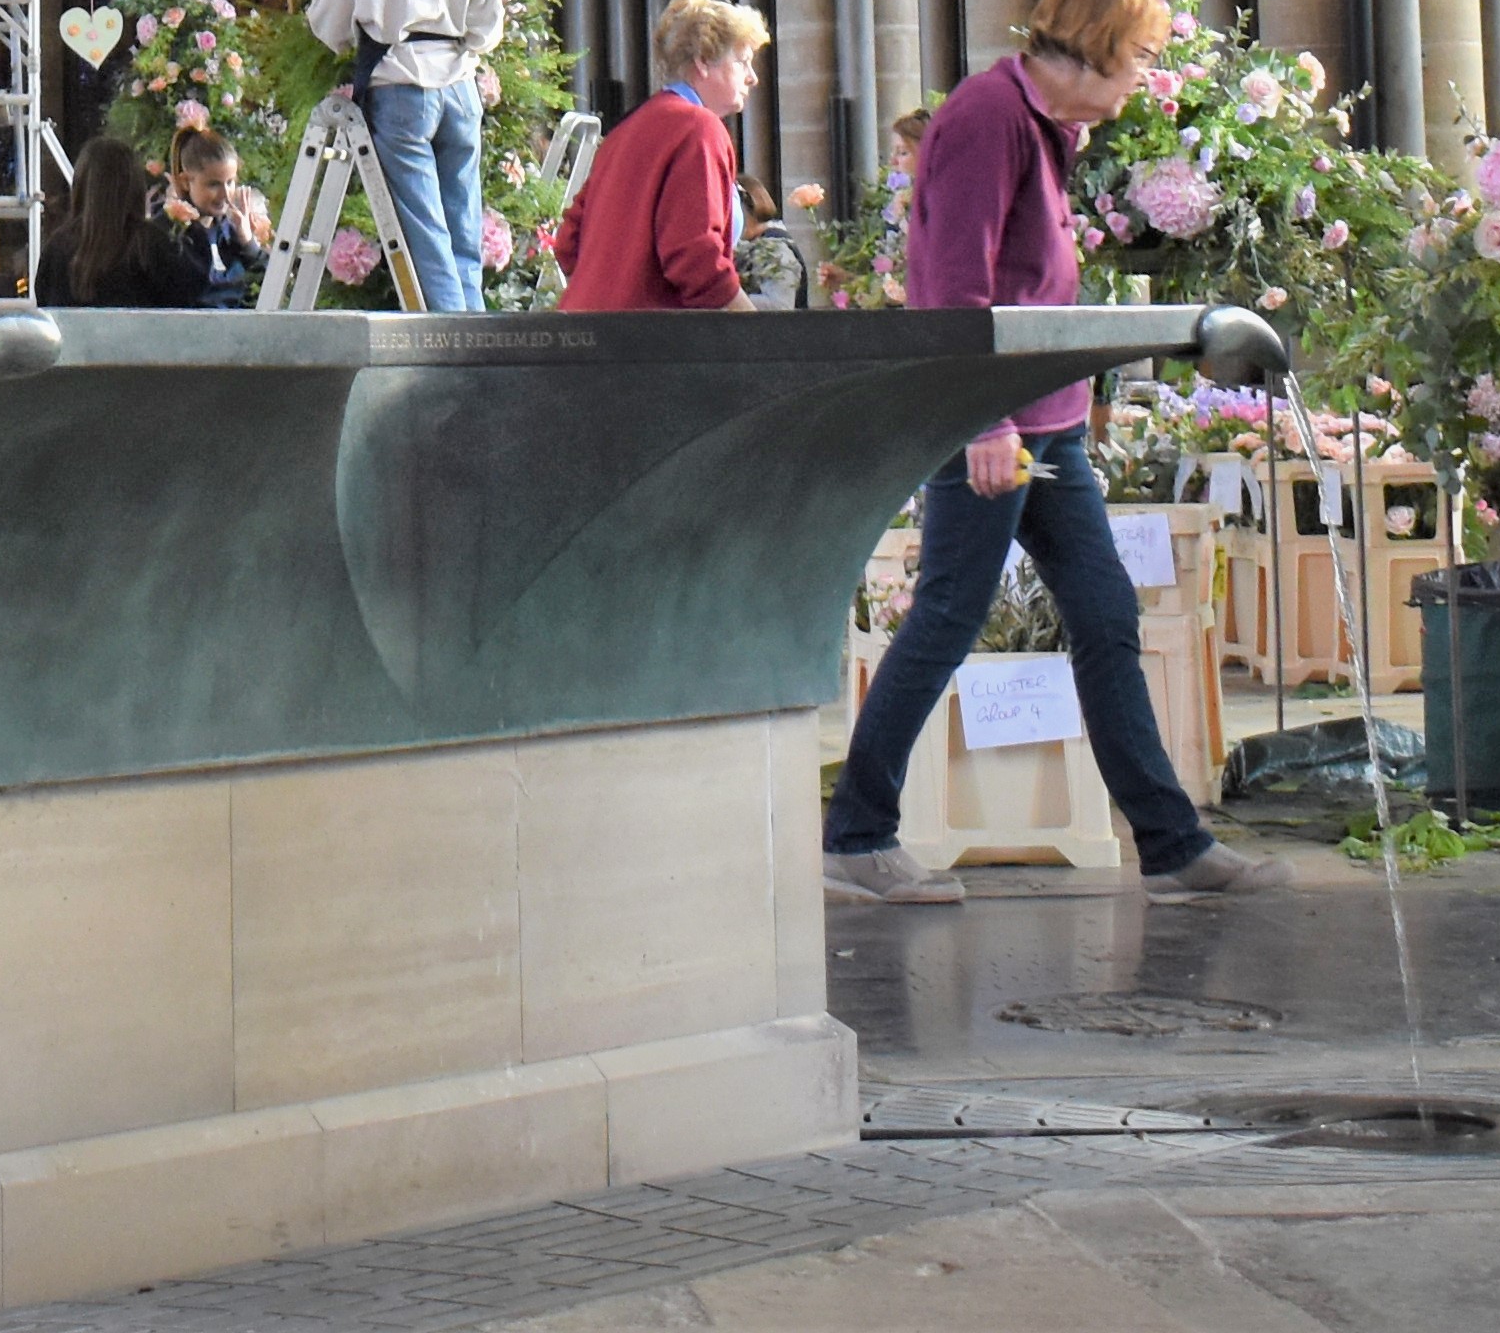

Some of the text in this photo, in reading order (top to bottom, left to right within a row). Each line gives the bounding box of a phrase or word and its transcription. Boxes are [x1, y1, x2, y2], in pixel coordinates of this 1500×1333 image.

[423, 332, 461, 348] HAVE
[465, 331, 553, 348] REDEEMED
[558, 331, 598, 347] YOU.
[970, 674, 1048, 698] CLUSTER
